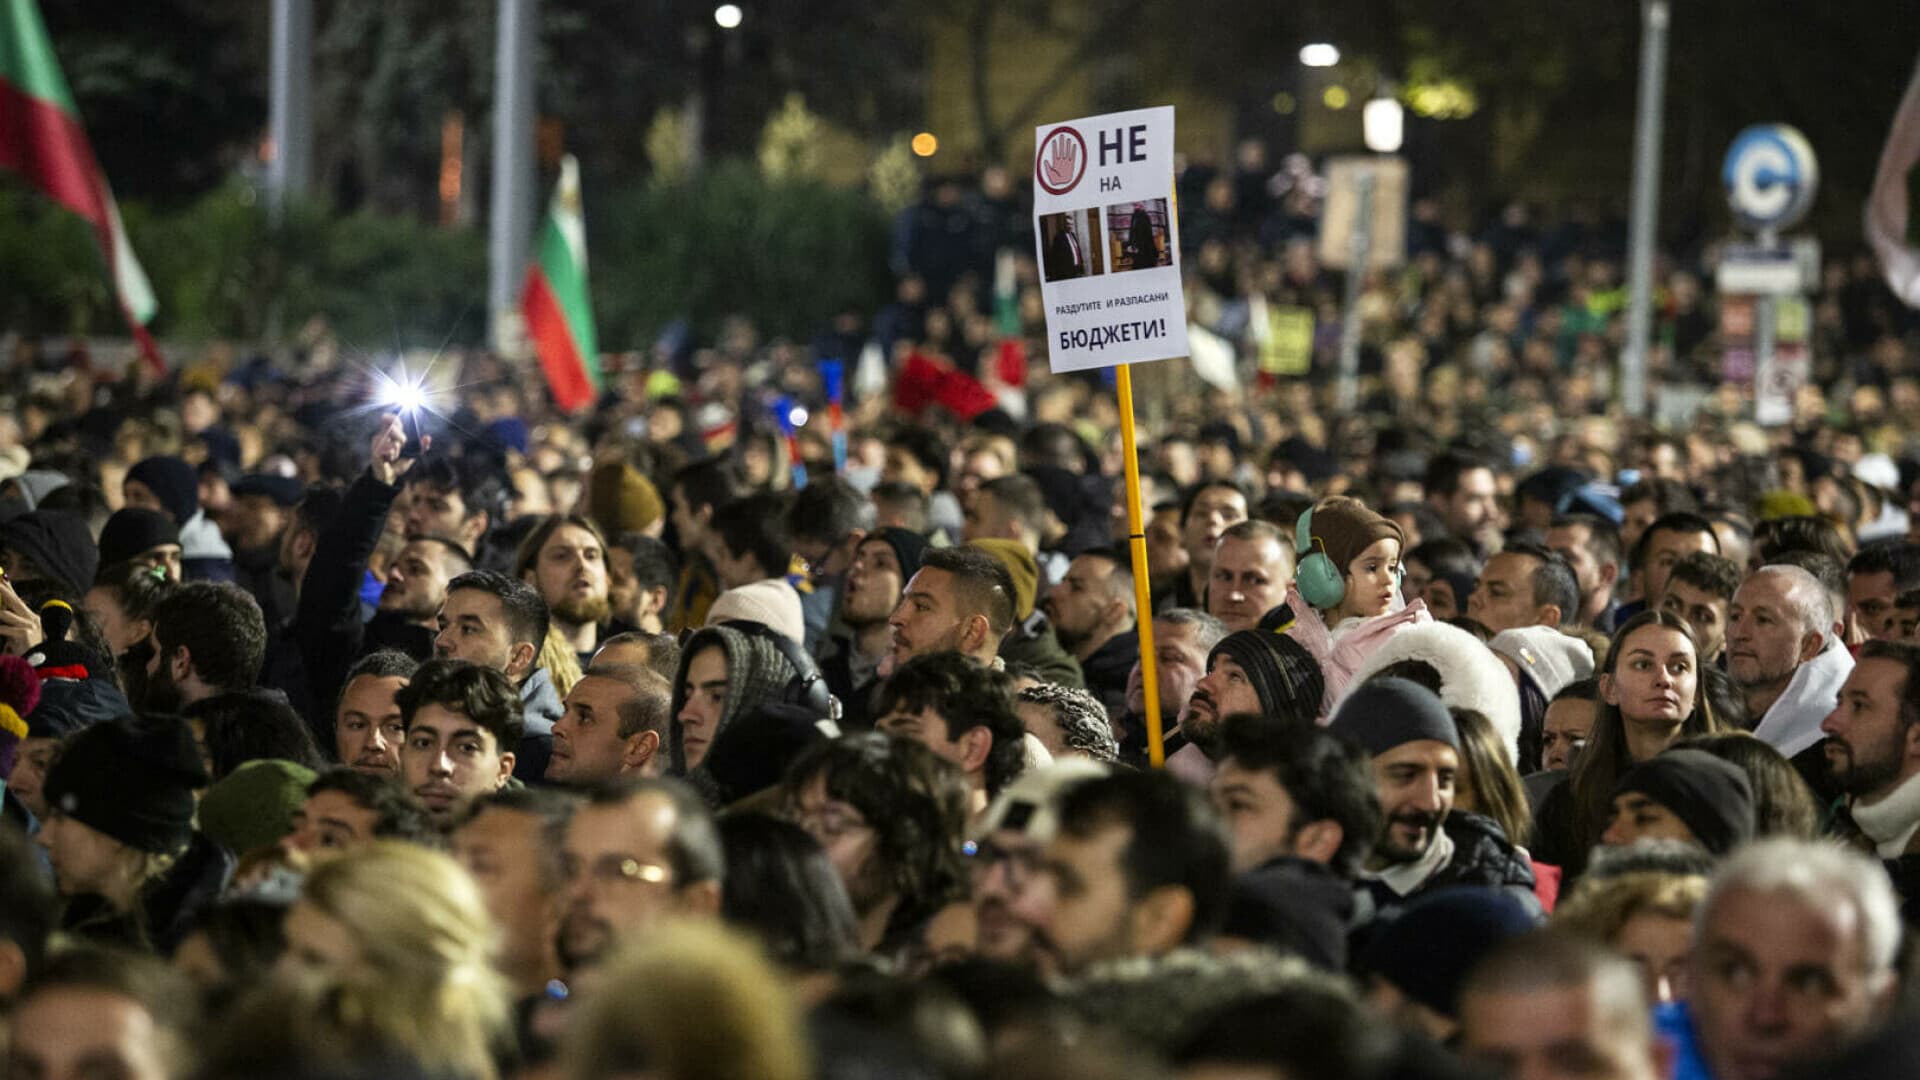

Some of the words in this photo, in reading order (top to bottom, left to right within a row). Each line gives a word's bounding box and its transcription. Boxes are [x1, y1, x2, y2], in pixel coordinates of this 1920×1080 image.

[1099, 124, 1147, 167] НЕ
[1100, 175, 1122, 193] НА
[1055, 298, 1101, 315] РАЗДУТИТЕ
[1106, 297, 1114, 308] И
[1114, 292, 1169, 308] РАЗПАСАНИ
[1060, 318, 1167, 351] БЮДЖЕТИ!
